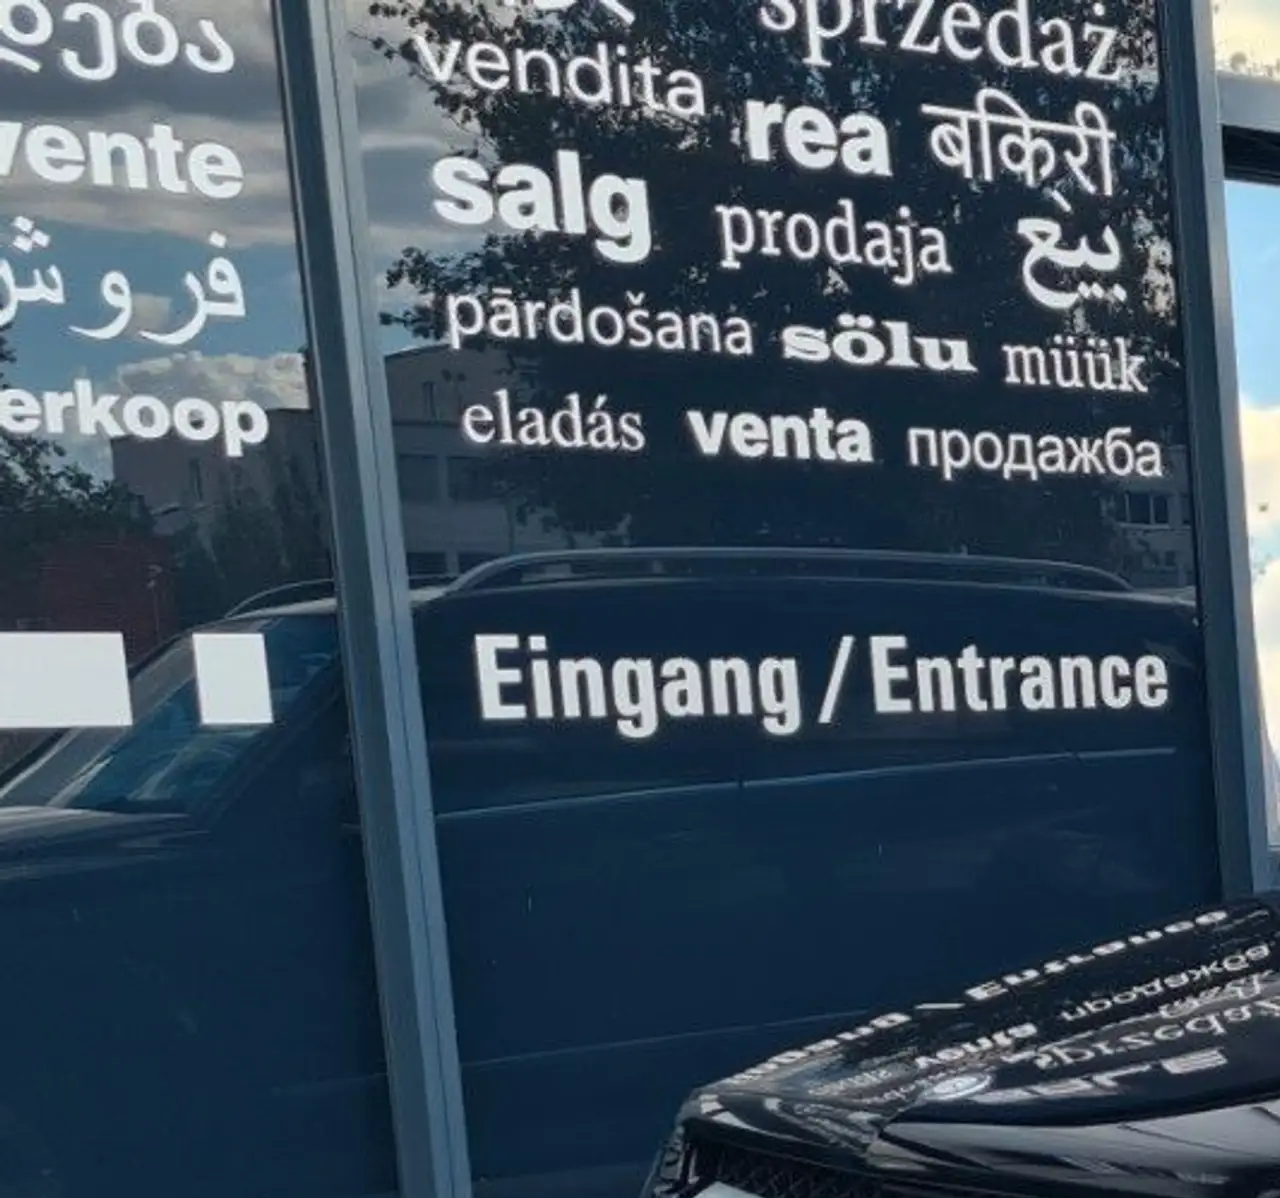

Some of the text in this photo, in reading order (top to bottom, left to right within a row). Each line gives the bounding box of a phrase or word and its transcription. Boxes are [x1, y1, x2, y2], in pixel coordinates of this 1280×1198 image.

[760, 0, 1121, 81] sprzedaż
[417, 36, 704, 117] vendita
[745, 100, 890, 176] rea
[430, 149, 651, 263] salg
[716, 200, 952, 286] prodaja
[1016, 217, 1127, 309] بيع
[447, 290, 752, 355] pārdošana
[782, 313, 977, 372] sölu
[1003, 338, 1146, 392] müük
[462, 388, 645, 450] eladás
[688, 408, 873, 462] venta
[908, 428, 1162, 480] продажба
